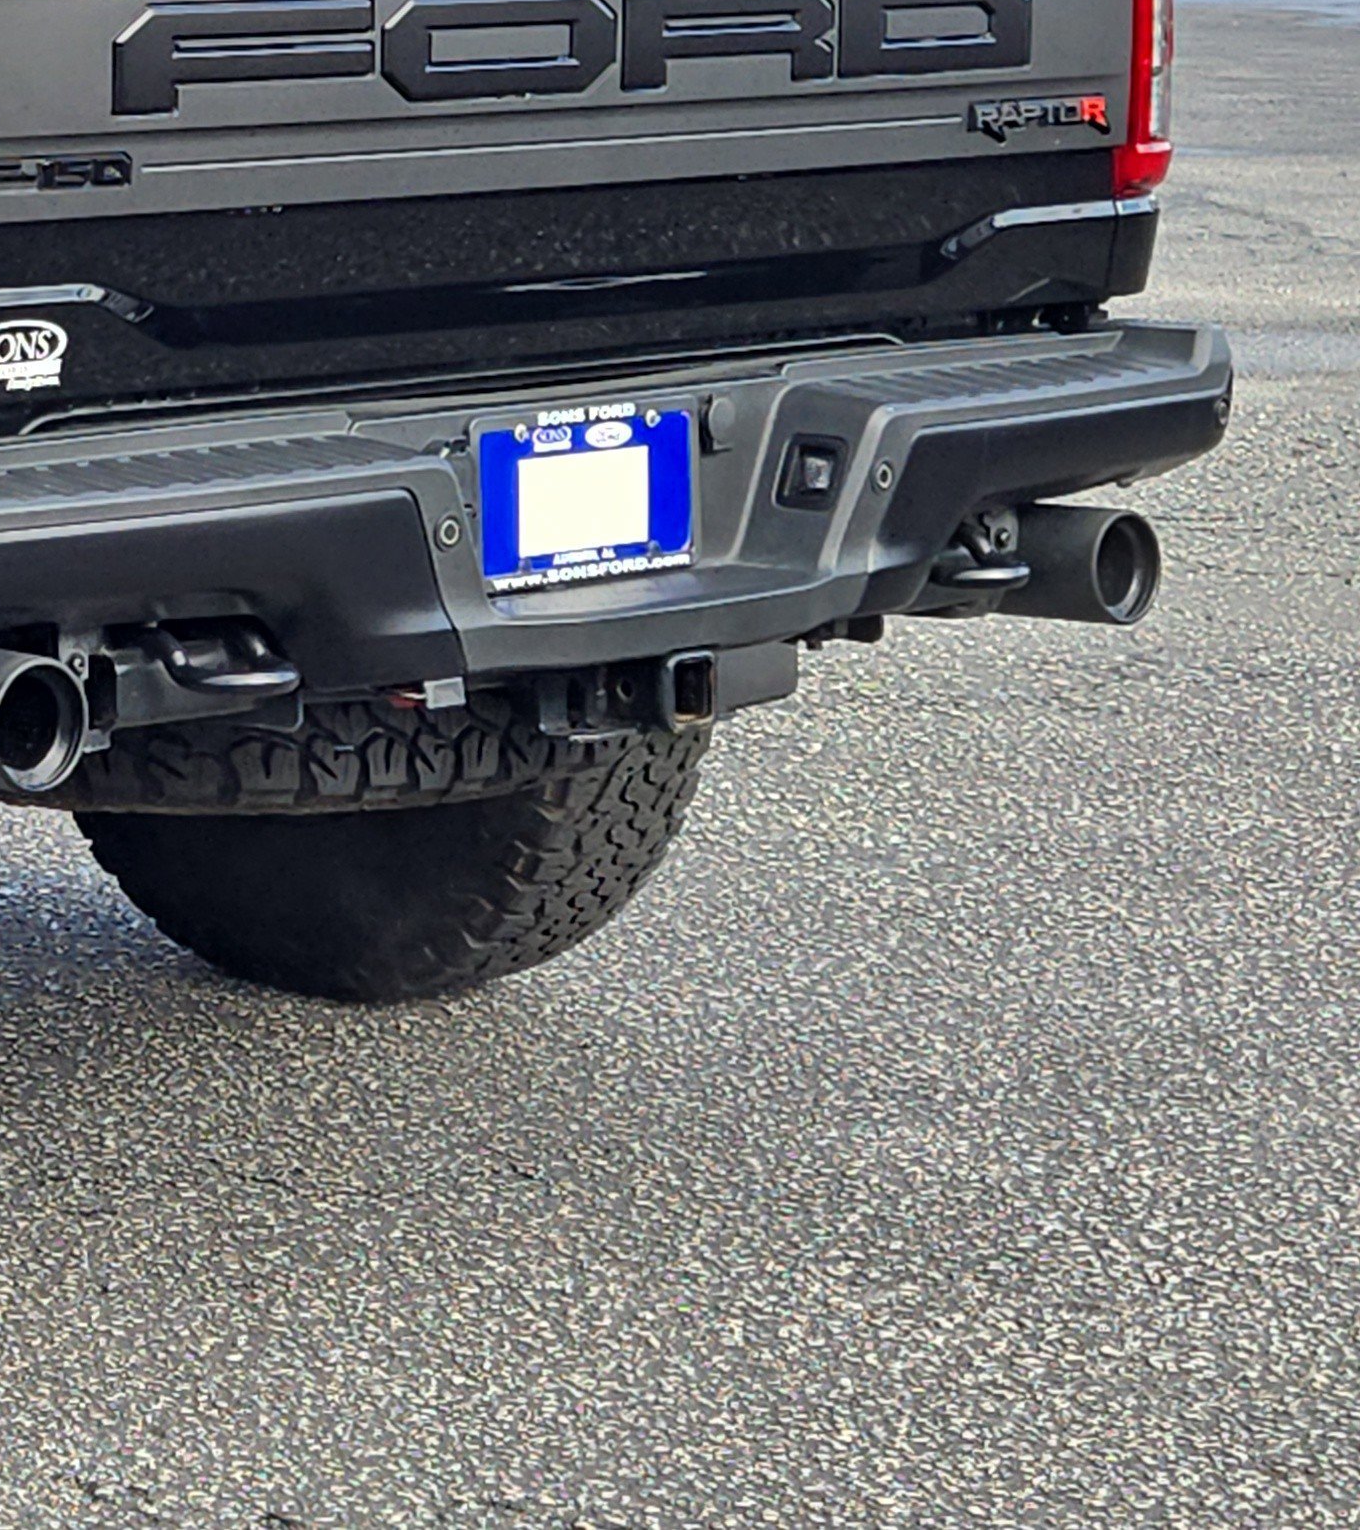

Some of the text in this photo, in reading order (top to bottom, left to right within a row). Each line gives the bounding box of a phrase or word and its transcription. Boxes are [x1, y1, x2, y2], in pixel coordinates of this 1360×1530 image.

[967, 93, 1111, 143] RAPTOR
[537, 402, 636, 427] SONS FORD
[491, 553, 692, 592] www.SONSFORD.com
